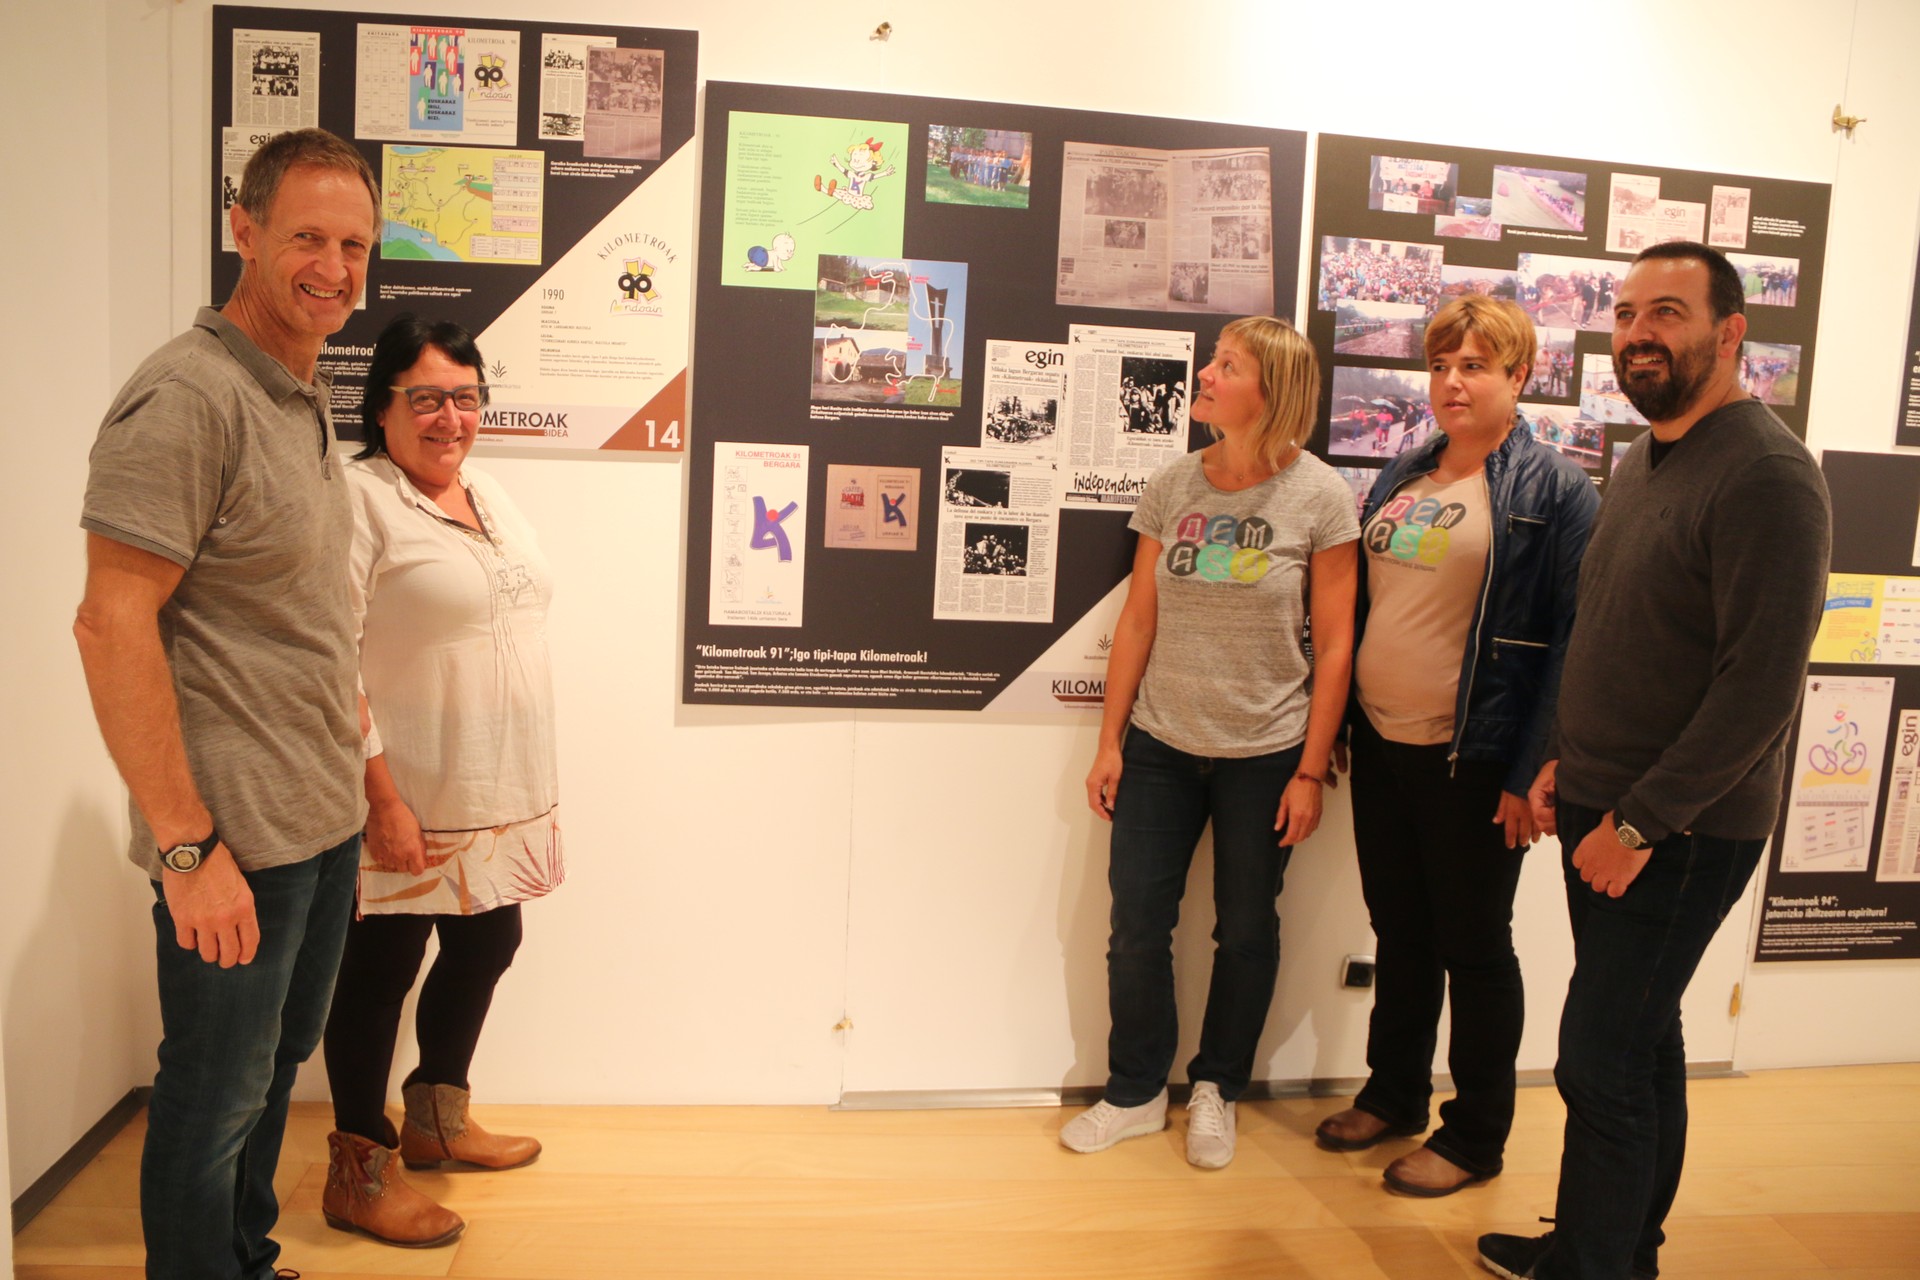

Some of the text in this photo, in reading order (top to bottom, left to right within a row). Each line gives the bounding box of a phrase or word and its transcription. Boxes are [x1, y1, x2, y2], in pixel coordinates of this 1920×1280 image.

[249, 133, 272, 147] egi
[1664, 206, 1686, 218] egin
[597, 232, 678, 264] KILOMETROAK
[543, 289, 565, 300] 1990
[320, 341, 377, 356] ilometroa
[1025, 348, 1064, 369] egin
[543, 429, 568, 438] BIDEA
[645, 419, 681, 448] 14
[735, 450, 791, 459] KILOMETROAK
[763, 460, 801, 469] BERGARA
[695, 645, 767, 659] “Kilometroak
[813, 648, 857, 664] tipi-tapa
[860, 649, 928, 663] Kilometroak!
[1901, 714, 1919, 757] egin
[1768, 896, 1819, 907] “Kilometroak
[1765, 907, 1888, 920] jatorrizko ibiltzearen espiritura!
